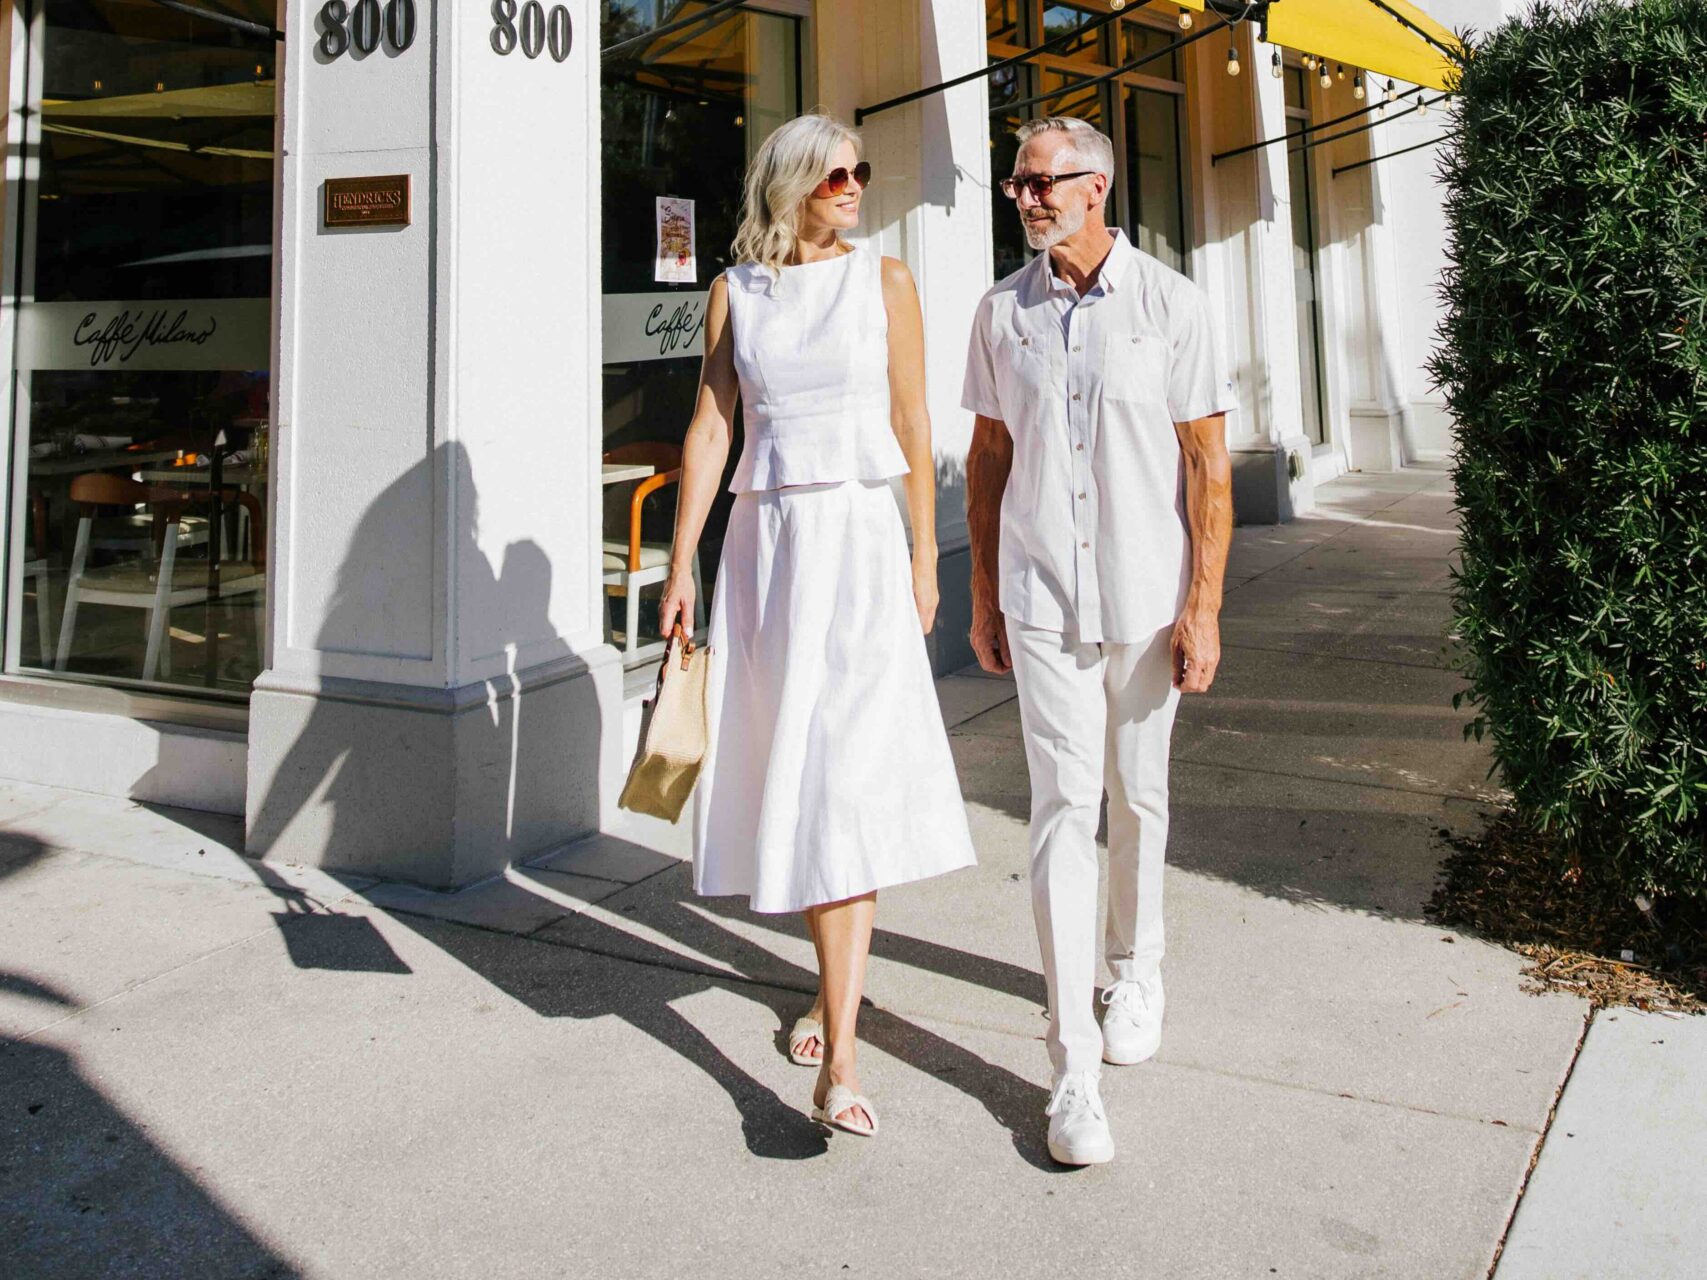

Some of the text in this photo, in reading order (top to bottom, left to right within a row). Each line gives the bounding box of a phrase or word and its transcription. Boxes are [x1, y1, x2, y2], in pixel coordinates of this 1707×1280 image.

[333, 190, 401, 208] HENDRICKS
[74, 309, 217, 367] Caffé Milano
[645, 301, 699, 356] Caffé
